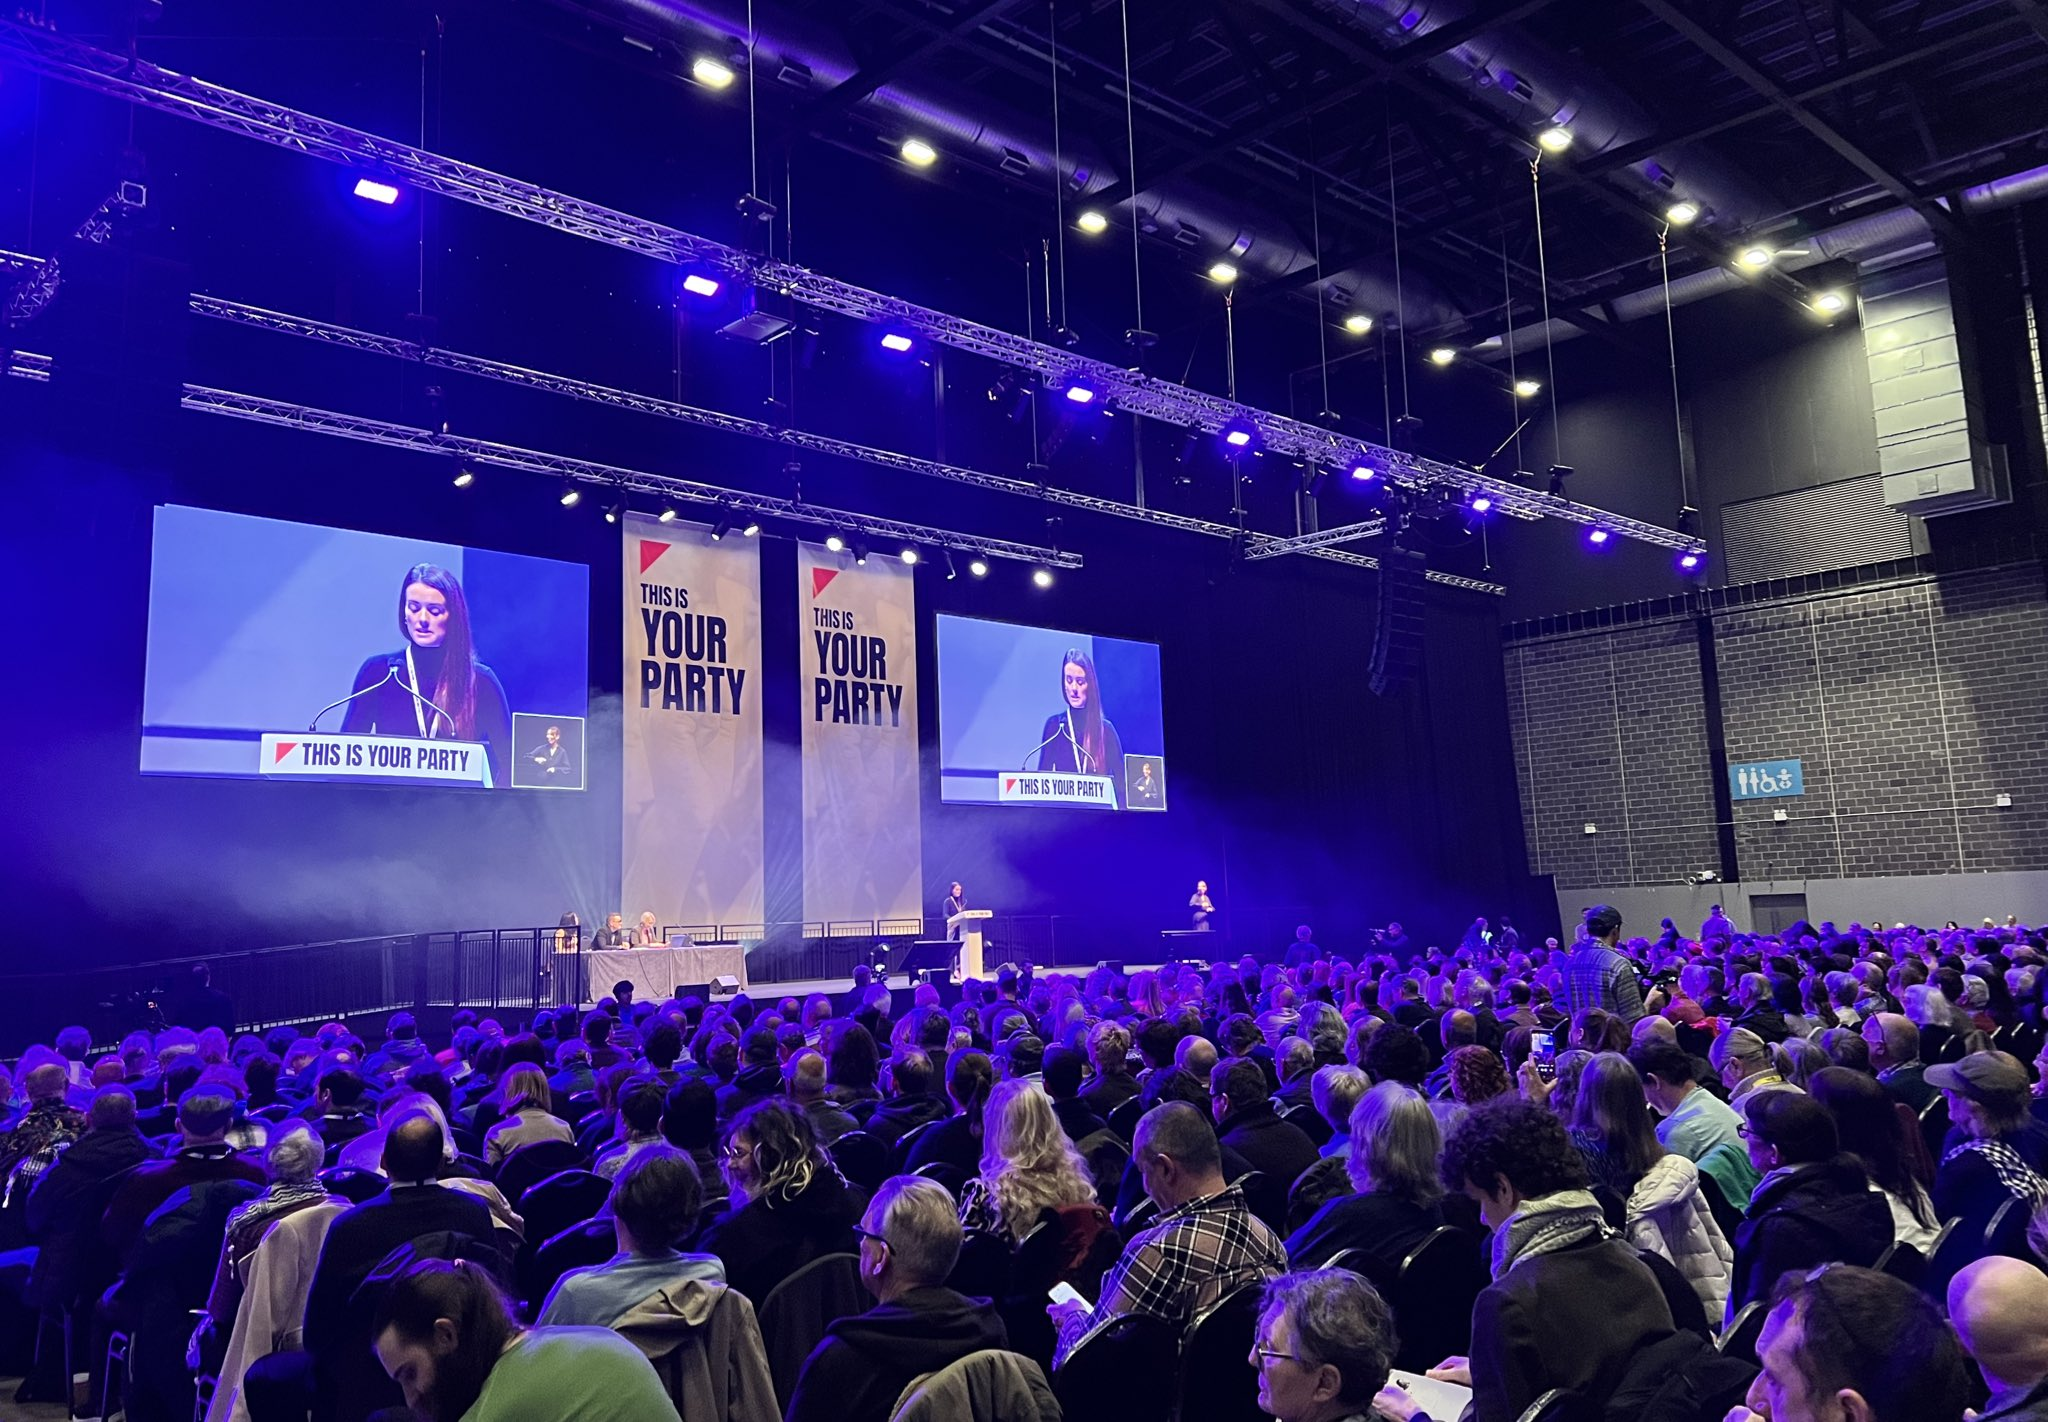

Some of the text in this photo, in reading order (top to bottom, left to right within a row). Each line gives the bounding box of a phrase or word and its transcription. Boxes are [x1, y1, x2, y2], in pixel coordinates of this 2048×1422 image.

[640, 583, 688, 609] THIS IS
[641, 607, 727, 664] YOUR
[813, 607, 853, 630] THIS IS
[814, 630, 887, 680] YOUR
[640, 659, 746, 715] PARTY
[814, 677, 903, 727] PARTY
[302, 743, 469, 772] THIS IS YOUR PARTY
[1019, 778, 1104, 798] THIS IS YOUR PARTY
